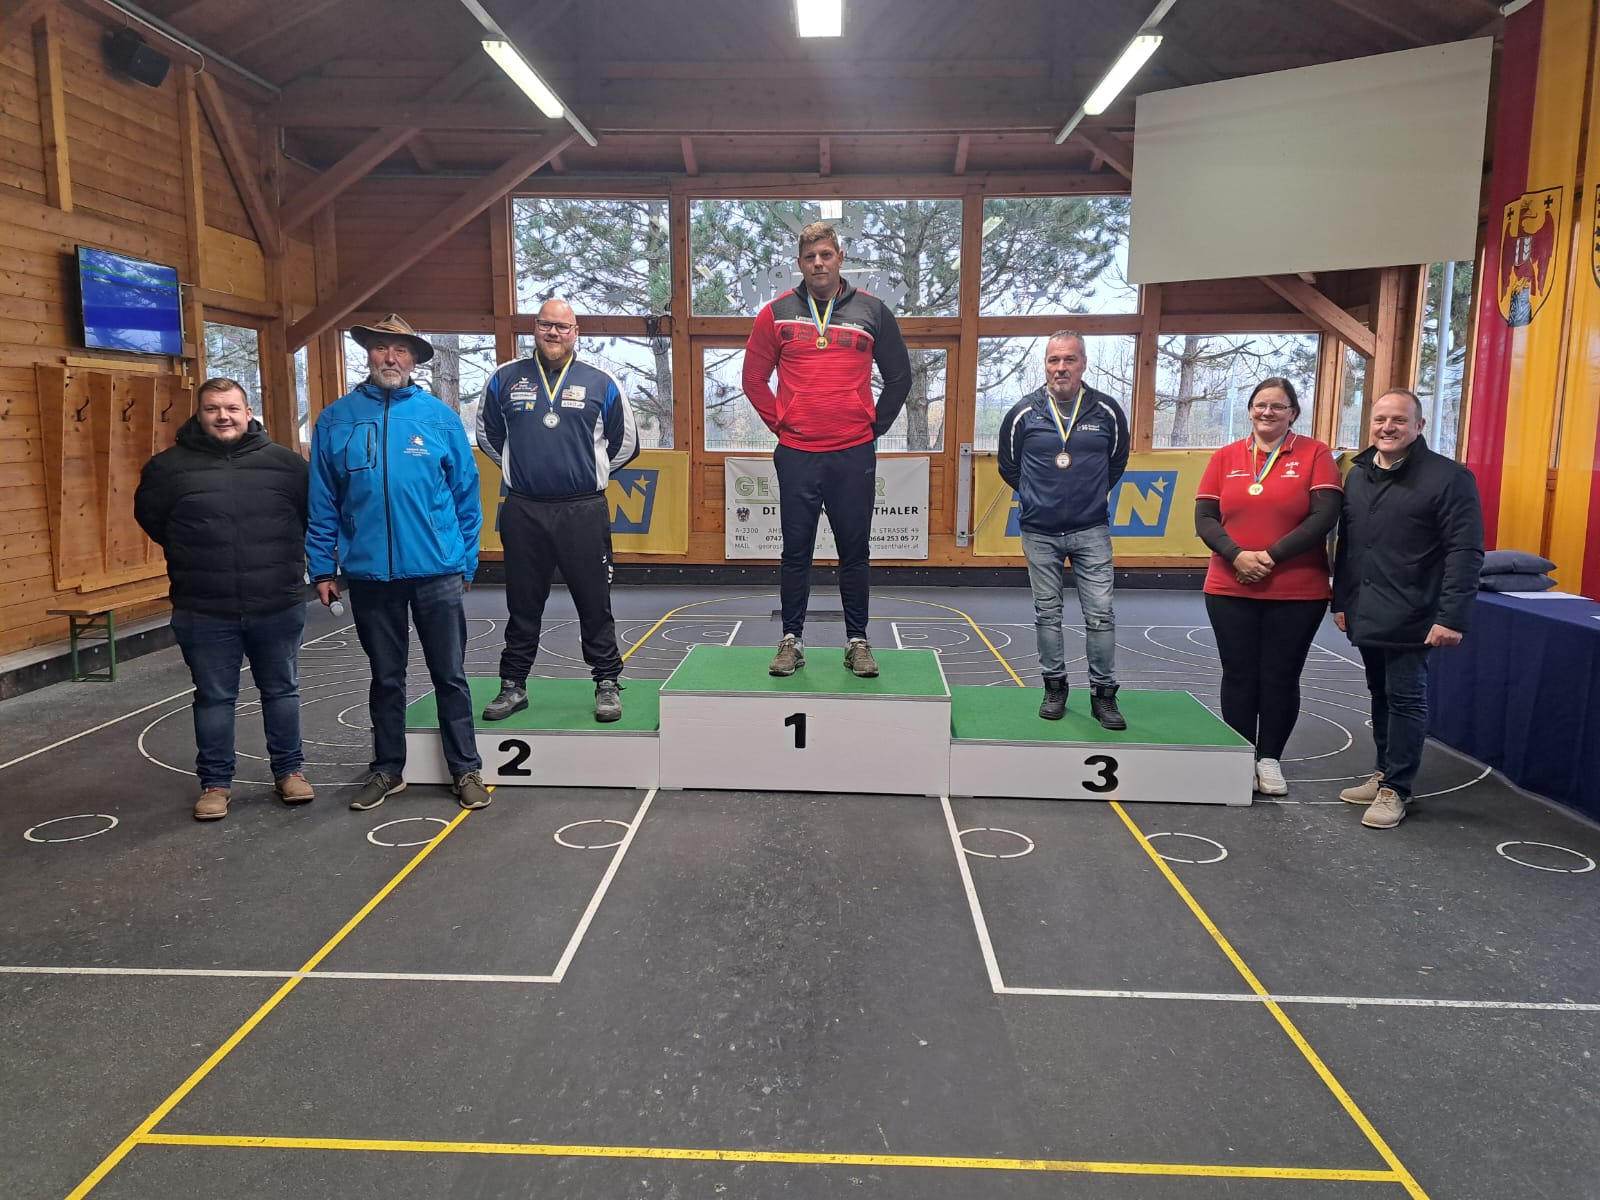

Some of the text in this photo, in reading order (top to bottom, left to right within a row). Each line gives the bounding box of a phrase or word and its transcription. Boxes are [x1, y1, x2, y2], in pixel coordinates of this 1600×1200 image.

[874, 506, 919, 515] THALER
[784, 712, 806, 749] 1
[497, 739, 532, 777] 2
[1081, 754, 1119, 793] 3
